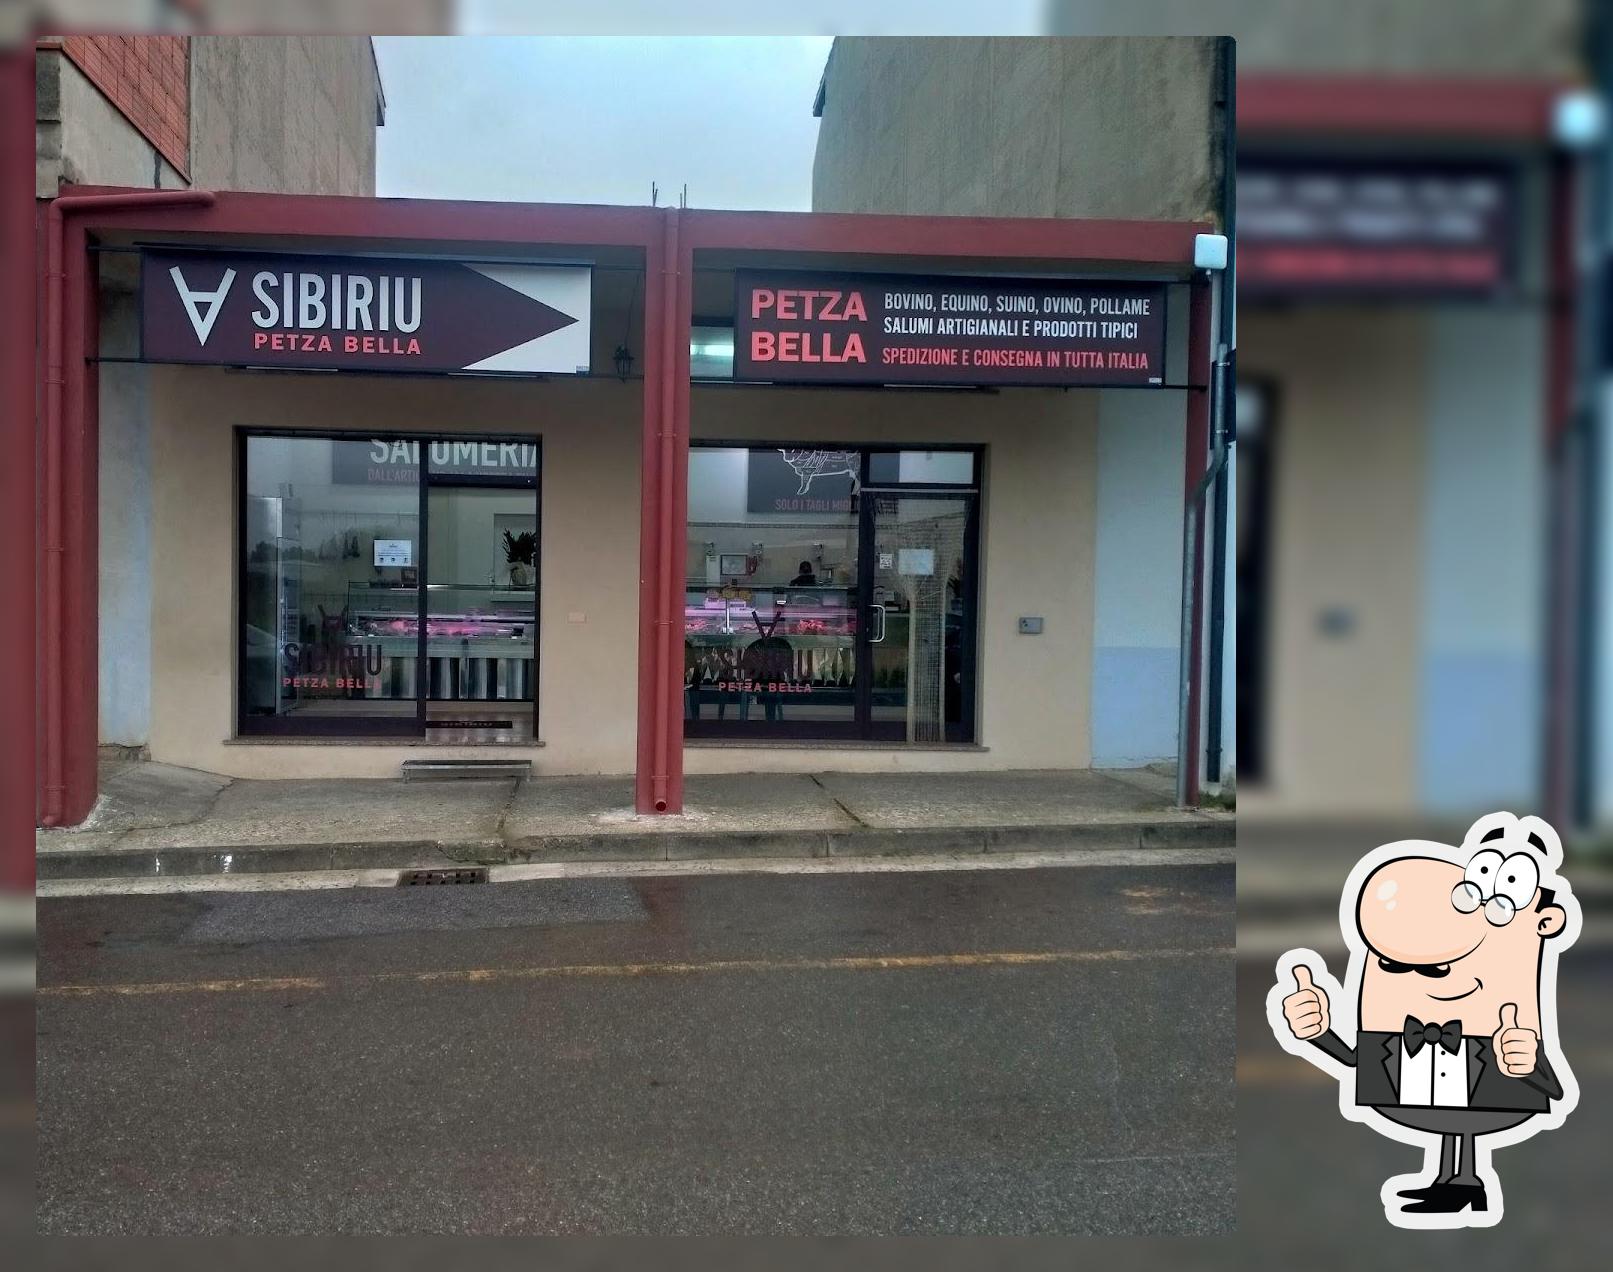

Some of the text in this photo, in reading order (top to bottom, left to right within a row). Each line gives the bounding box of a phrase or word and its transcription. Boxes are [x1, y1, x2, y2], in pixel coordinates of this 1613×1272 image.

[252, 270, 423, 333] SIBIRIU
[751, 289, 868, 322] PETZA
[884, 292, 1151, 317] BOVINO, EQUINO, SUINO, OVINO, POLLAME
[883, 316, 1139, 339] SALUMI ARTIGIANALI E PRODOTTI TIPICI
[254, 333, 421, 354] PETZA BELLA
[751, 331, 867, 364] BELLA
[882, 347, 1149, 370] SPEDIZIONE E CONSEGNA IN TUTTA ITALIA
[283, 677, 329, 688] PETZA
[719, 682, 812, 692] PETZA BELLA
